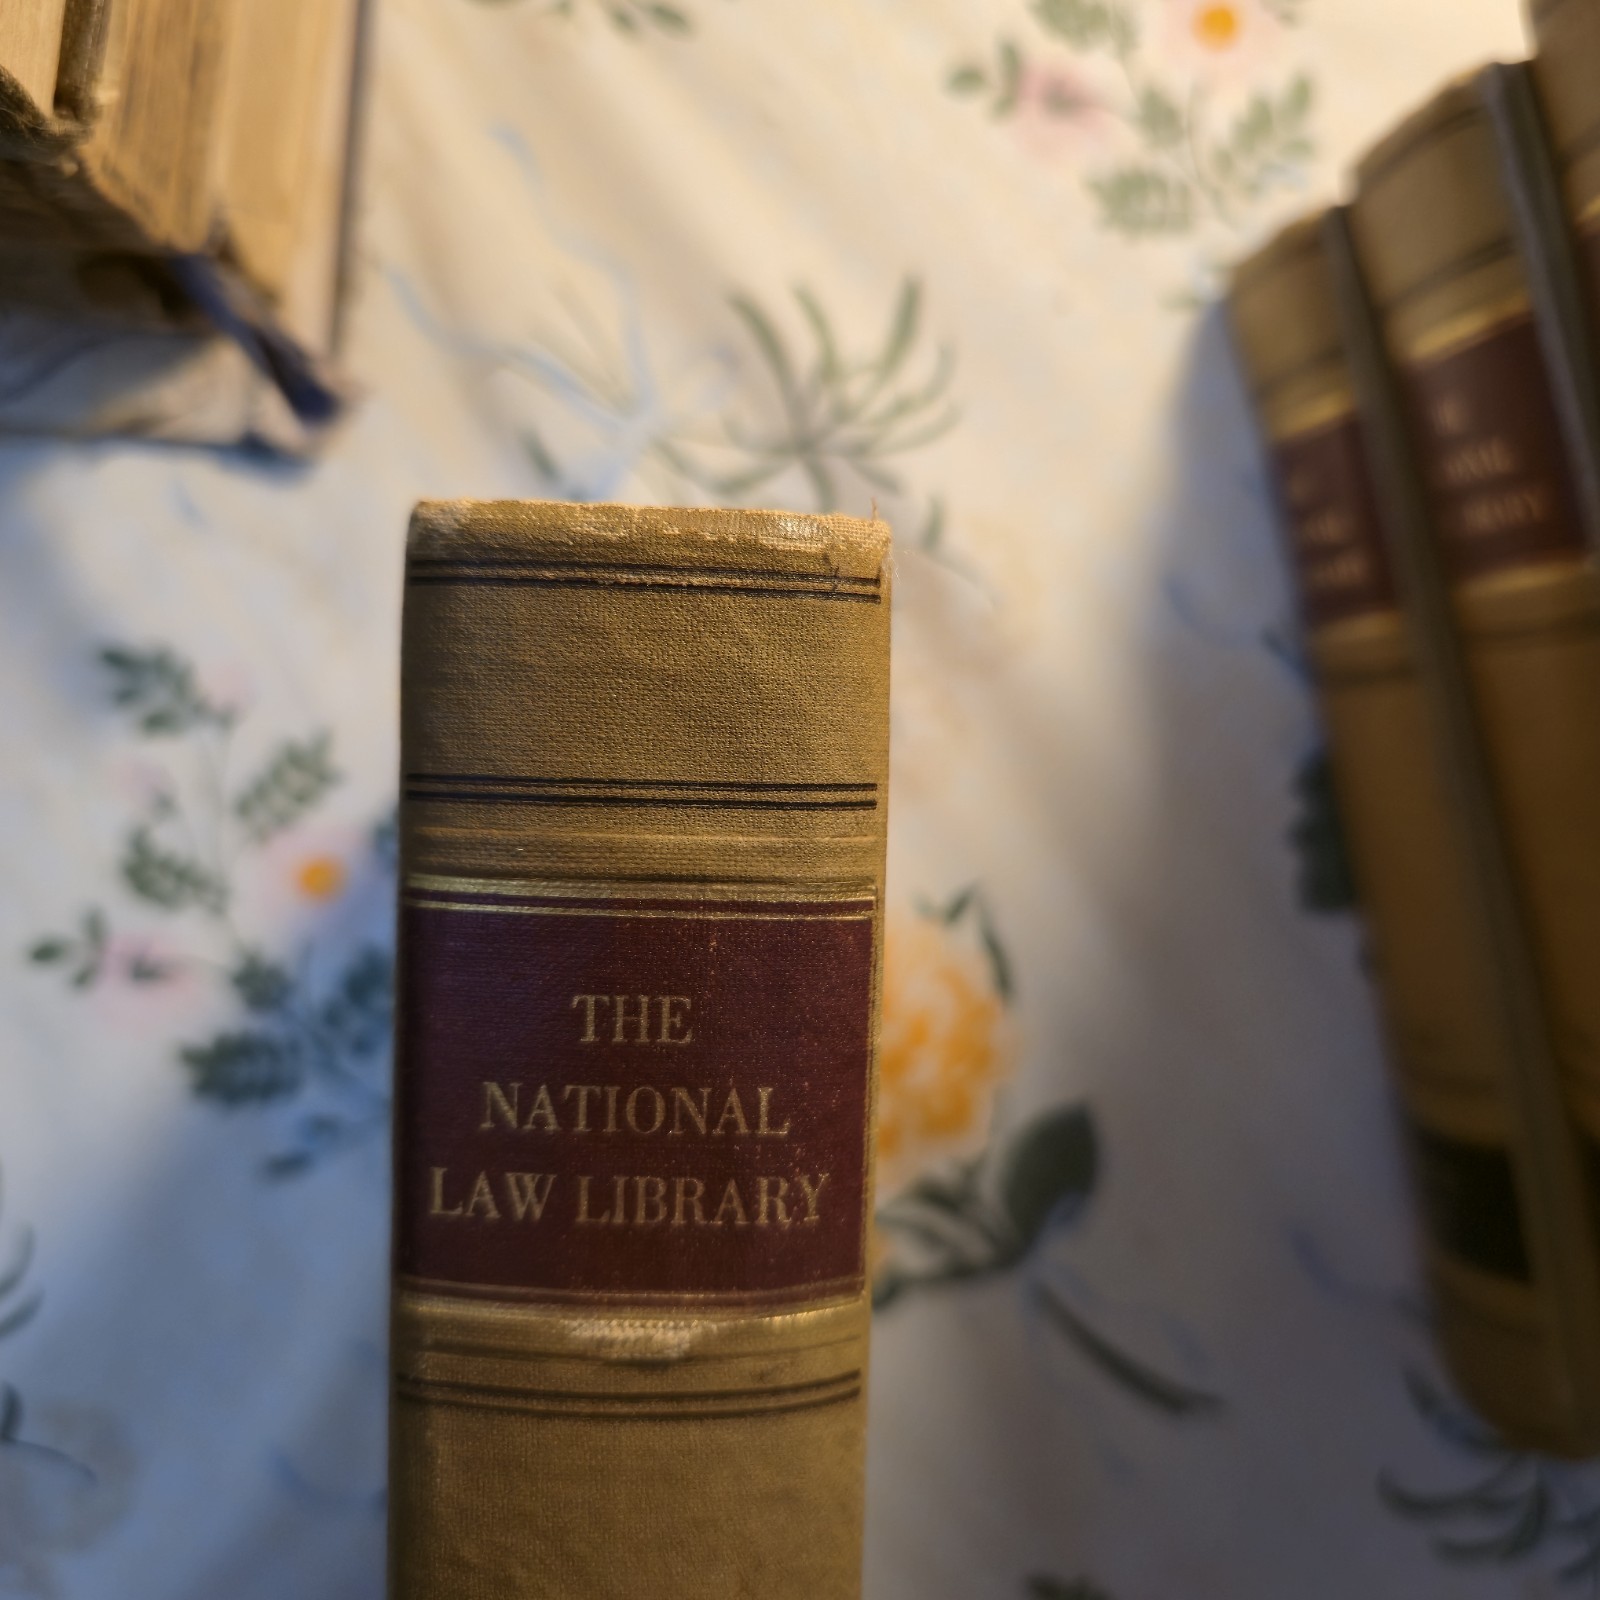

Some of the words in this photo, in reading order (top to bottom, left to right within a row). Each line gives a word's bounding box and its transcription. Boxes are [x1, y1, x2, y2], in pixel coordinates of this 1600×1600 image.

[571, 994, 694, 1045] THE
[479, 1081, 792, 1136] NATIONAL
[429, 1166, 557, 1221] LAW
[574, 1171, 831, 1226] LIBRARY
